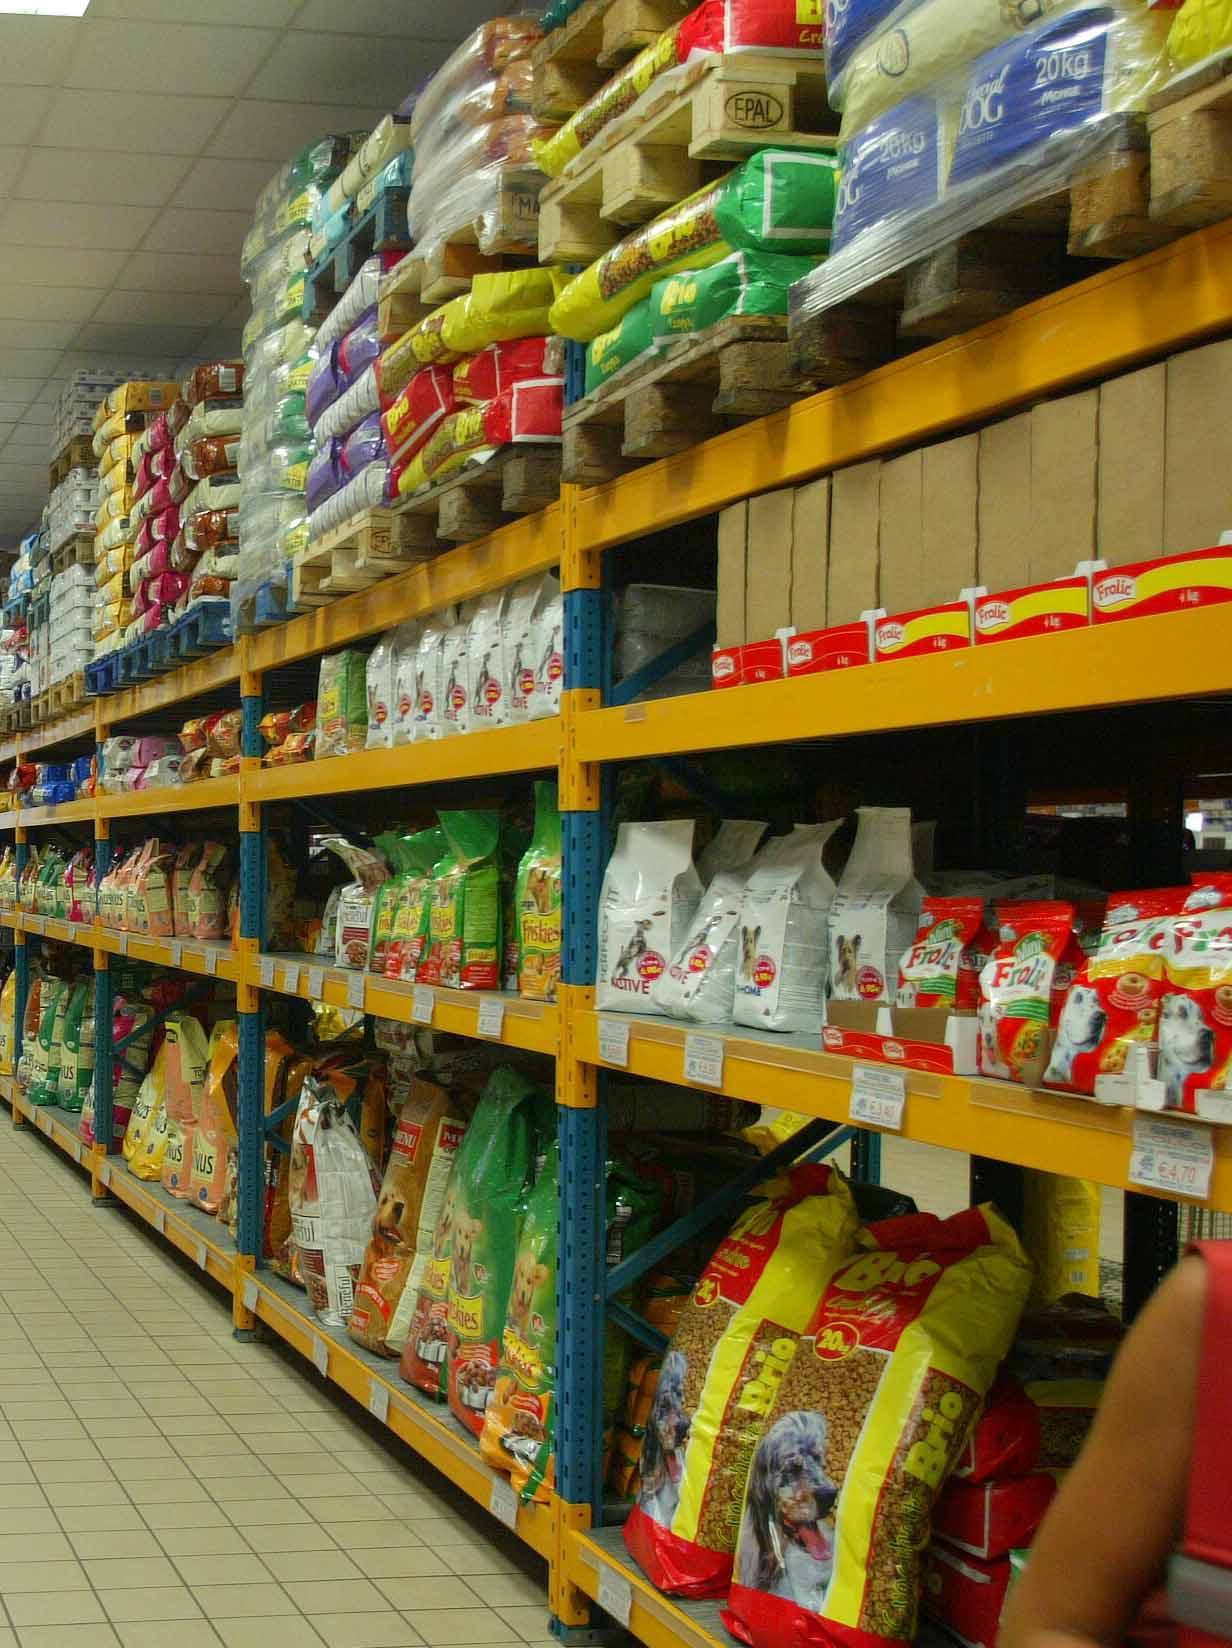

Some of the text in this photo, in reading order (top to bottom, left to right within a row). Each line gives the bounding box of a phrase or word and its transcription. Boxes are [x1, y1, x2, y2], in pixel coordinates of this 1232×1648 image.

[1035, 50, 1090, 84] 20kg
[734, 98, 774, 122] EPAL
[1096, 579, 1132, 601] Frolic
[977, 603, 1008, 623] Frolic
[611, 976, 650, 995] ACTIVE
[338, 1274, 353, 1319] Beneful
[736, 1337, 798, 1418] Brio
[904, 1391, 963, 1489] Brio
